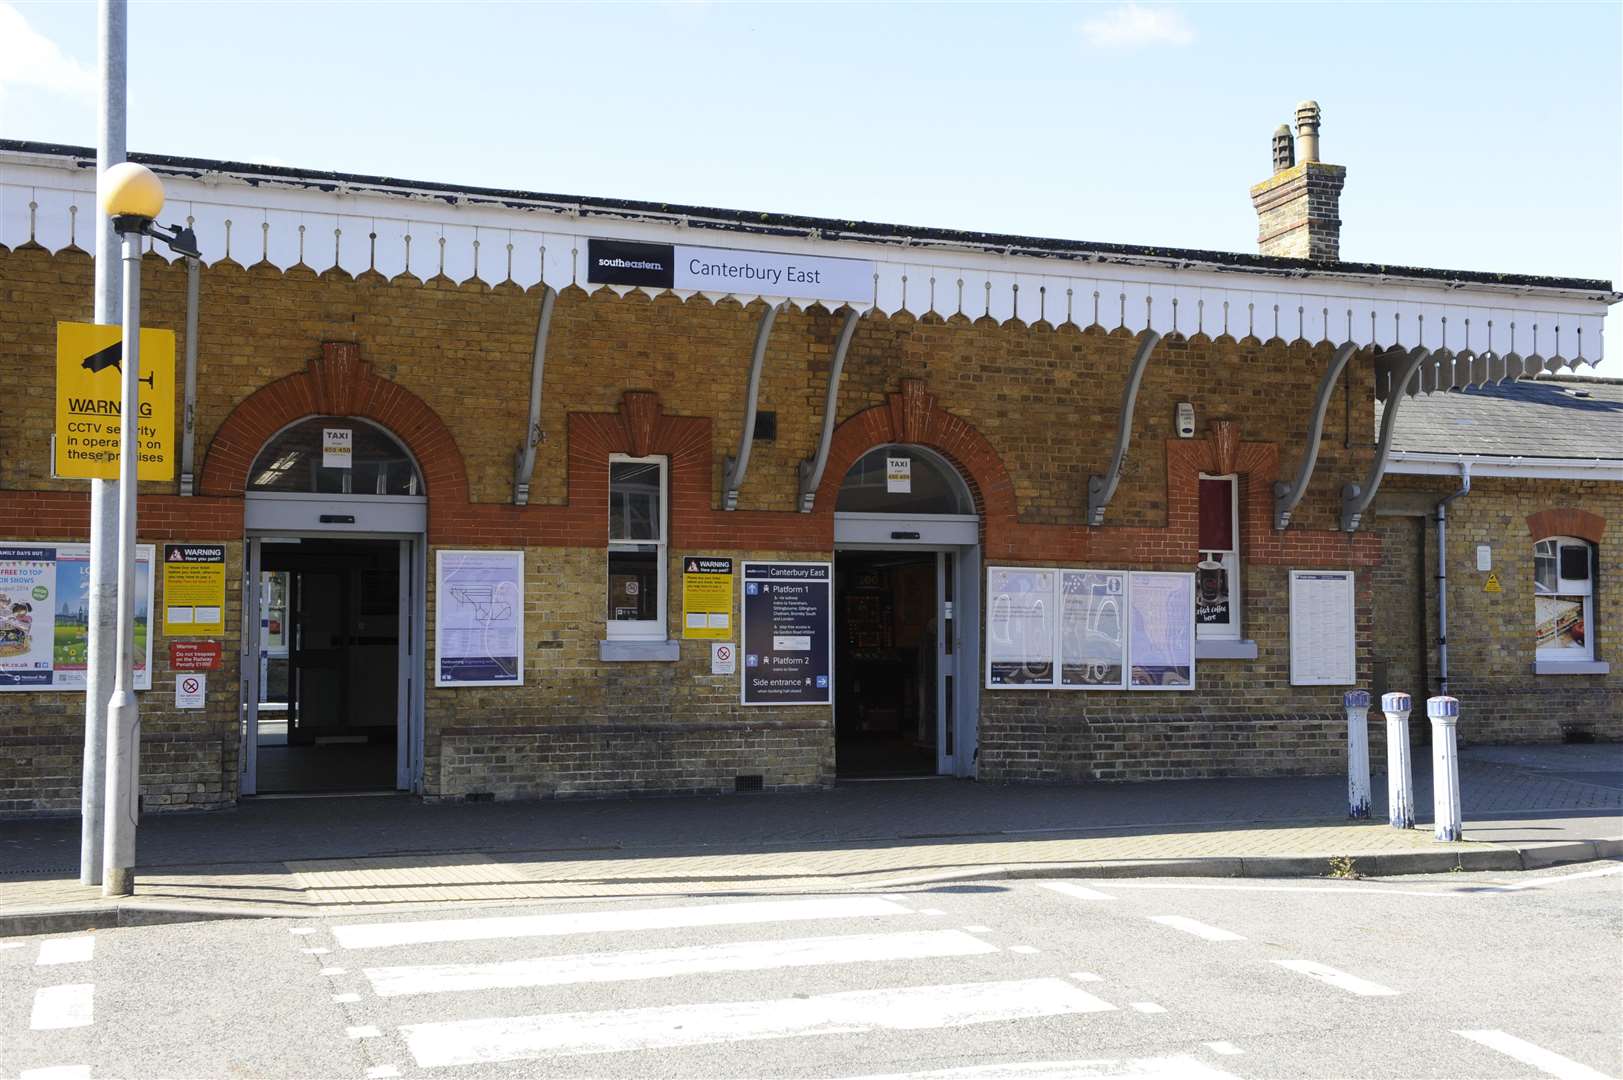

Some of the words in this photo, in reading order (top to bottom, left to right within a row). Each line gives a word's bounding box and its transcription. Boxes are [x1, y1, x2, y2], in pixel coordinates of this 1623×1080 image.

[598, 256, 663, 271] southeastern.
[689, 258, 782, 284] Canterbury
[787, 267, 821, 284] East
[68, 398, 152, 416] WARNG
[67, 422, 102, 433] CCTV
[106, 425, 156, 438] seity
[326, 432, 349, 440] TAXI
[67, 436, 78, 445] in
[82, 438, 142, 449] operan
[146, 441, 161, 449] on
[67, 449, 104, 460] these
[107, 452, 164, 463] prises
[770, 568, 809, 577] Canterbury
[810, 568, 825, 577] East
[772, 585, 803, 593] Platform
[1211, 605, 1227, 614] coffee
[772, 656, 803, 664] Platform
[752, 679, 769, 687] Side
[770, 679, 802, 687] entrance
